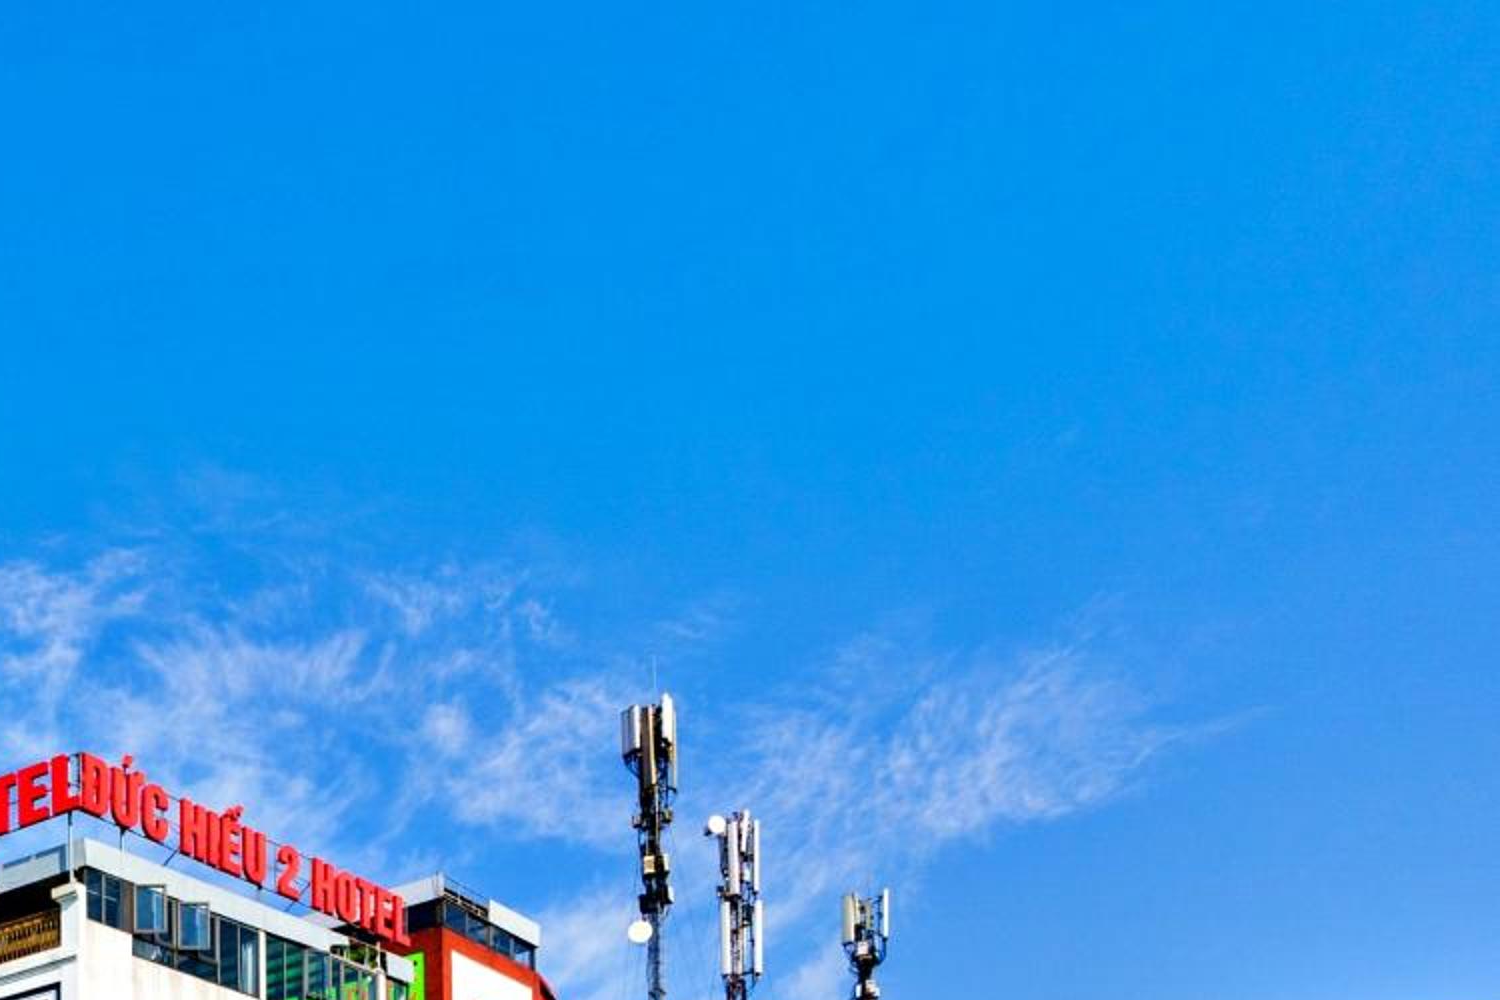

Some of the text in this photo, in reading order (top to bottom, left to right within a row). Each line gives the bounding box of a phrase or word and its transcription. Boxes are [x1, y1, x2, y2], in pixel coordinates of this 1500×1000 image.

[79, 752, 412, 947] ĐỨC HIẾU 2 HOTEL
